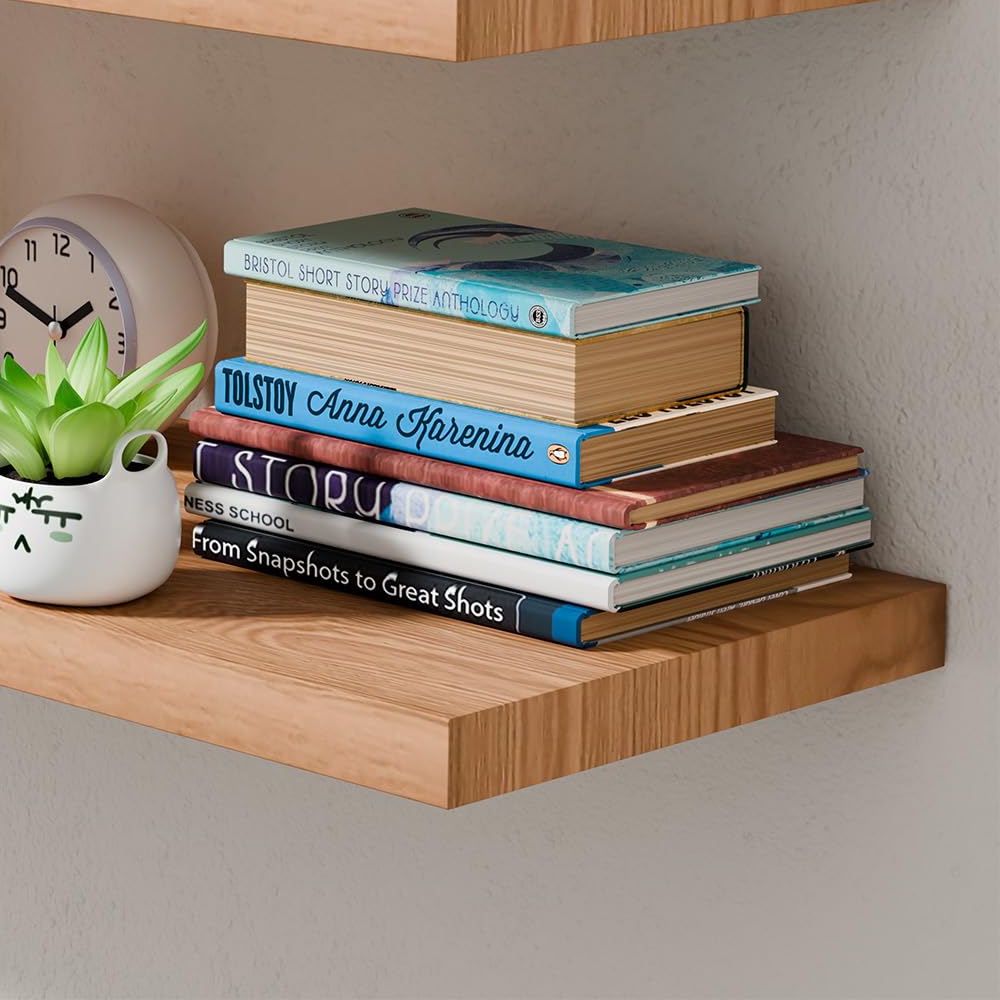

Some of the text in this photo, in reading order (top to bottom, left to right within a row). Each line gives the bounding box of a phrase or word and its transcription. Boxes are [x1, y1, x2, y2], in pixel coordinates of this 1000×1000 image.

[24, 238, 37, 262] 11
[53, 232, 71, 258] 12
[88, 250, 95, 274] 1
[0, 265, 19, 289] 10
[244, 253, 295, 280] BRISTOL
[298, 263, 342, 288] SHORT
[345, 273, 390, 298] STORY
[393, 282, 429, 306] PRIZE
[432, 289, 520, 323] ANTHOLOGY
[222, 367, 535, 460] TOLSTOY Anna Karenina
[231, 450, 387, 521] STORY
[229, 505, 295, 533] SCHOOL
[192, 526, 504, 623] From Snapshots to Great Shots
